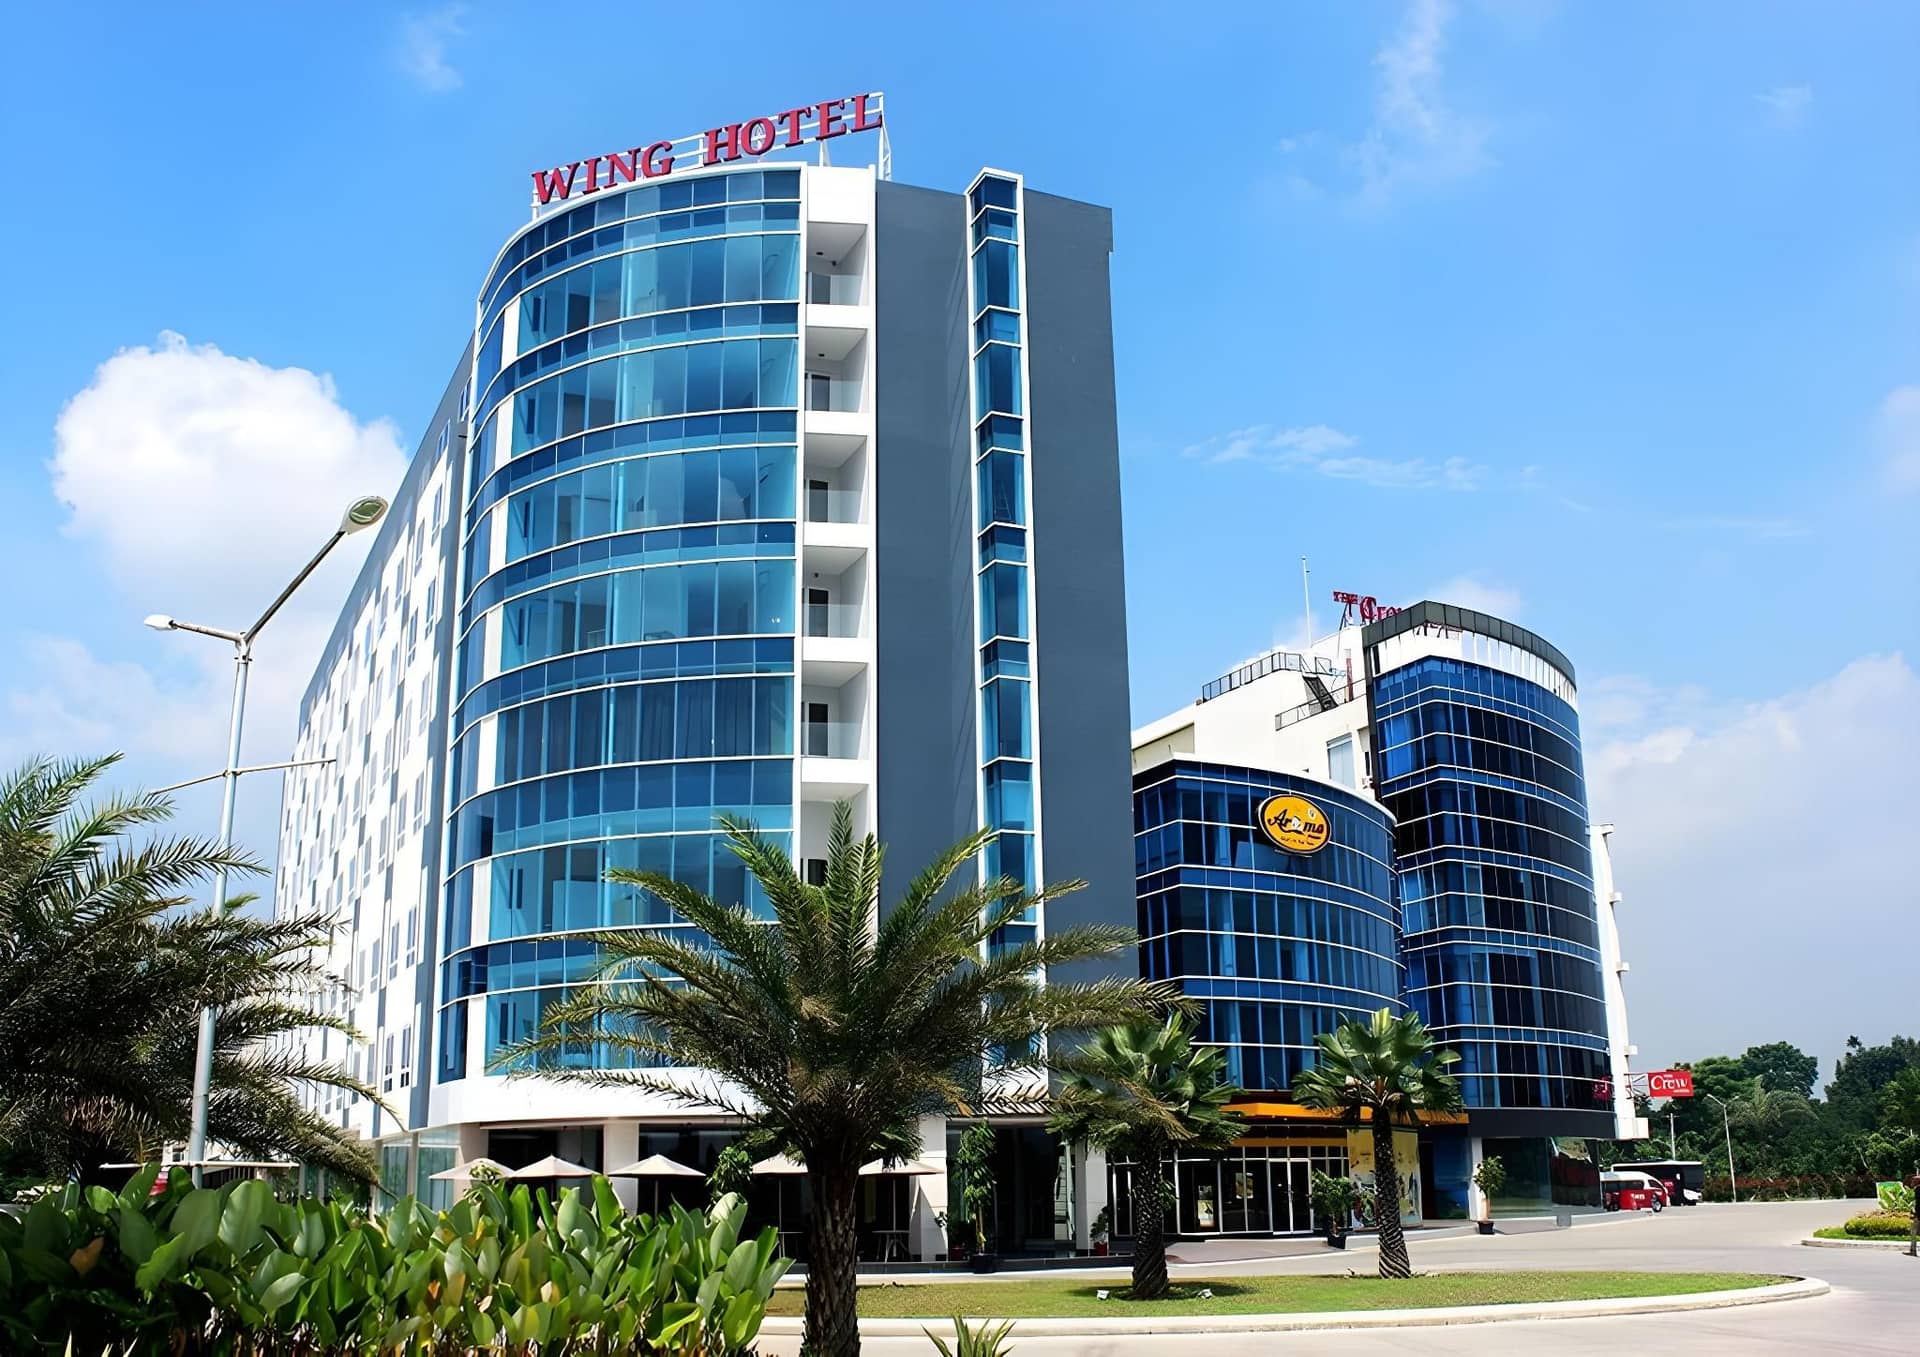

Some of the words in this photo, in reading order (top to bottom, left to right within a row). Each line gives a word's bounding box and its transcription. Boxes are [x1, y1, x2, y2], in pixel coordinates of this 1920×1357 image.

[532, 141, 675, 204] WING
[703, 94, 882, 167] HOTEL
[1360, 597, 1402, 620] Cre
[1651, 1075, 1688, 1090] Crew
